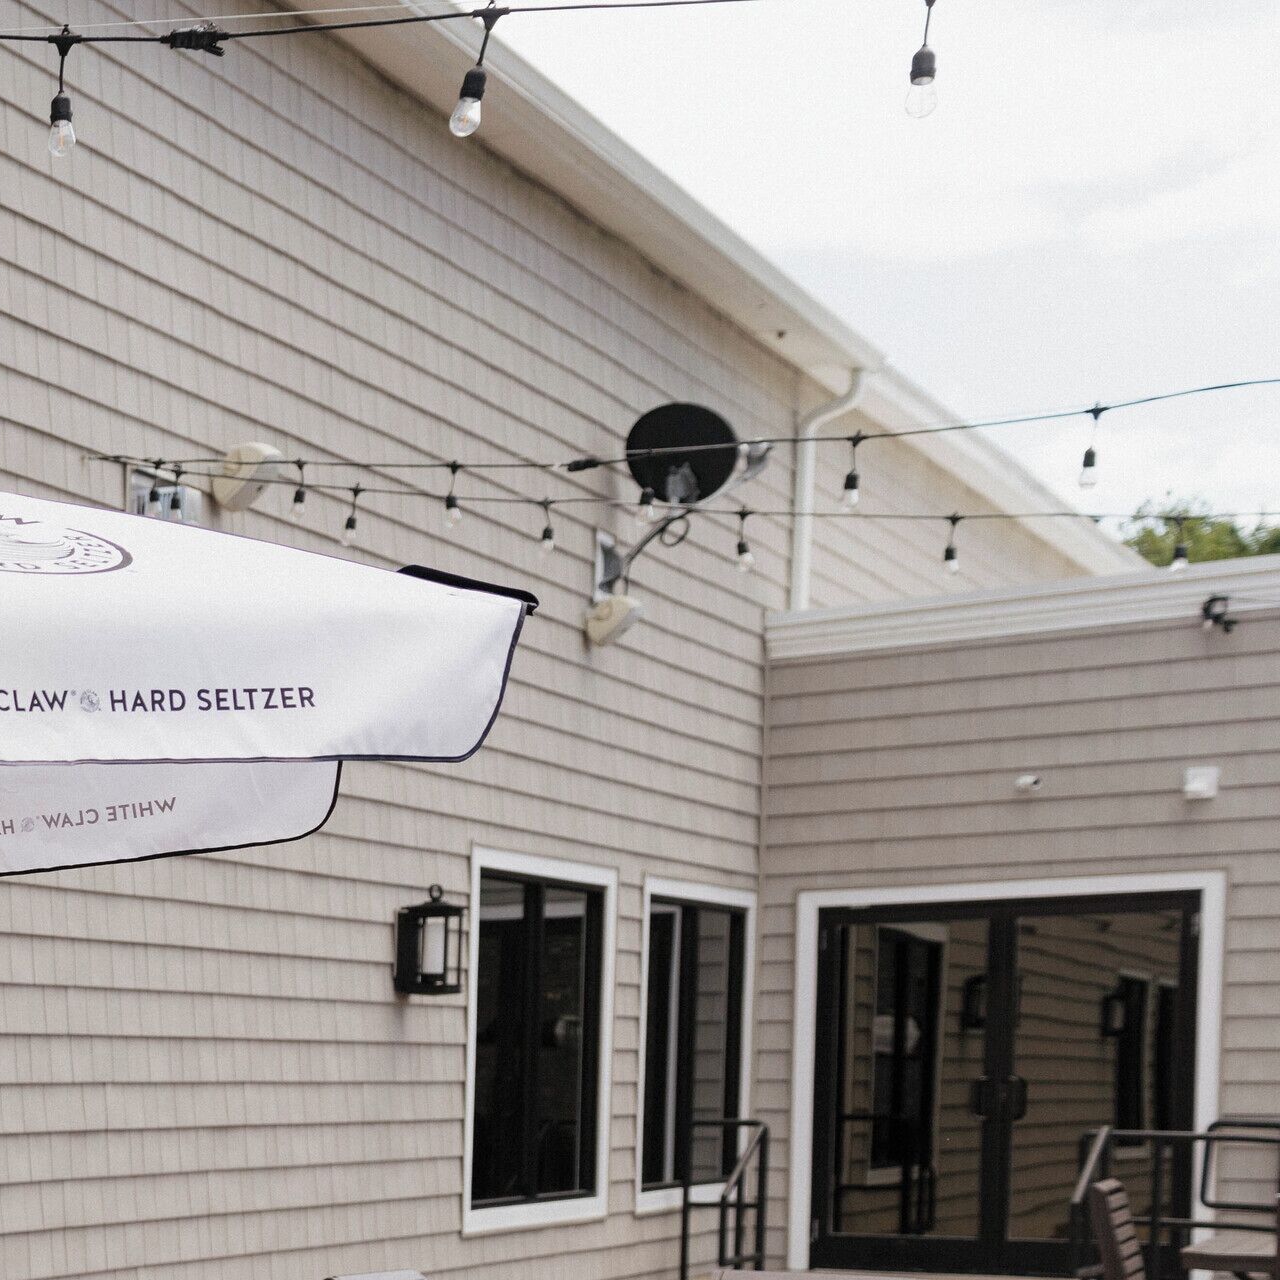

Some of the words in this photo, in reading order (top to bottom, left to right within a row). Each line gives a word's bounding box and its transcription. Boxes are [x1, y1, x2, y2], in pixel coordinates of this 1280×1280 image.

[53, 534, 112, 570] SELTZER
[109, 688, 187, 713] HARD
[197, 686, 317, 711] SELTZER
